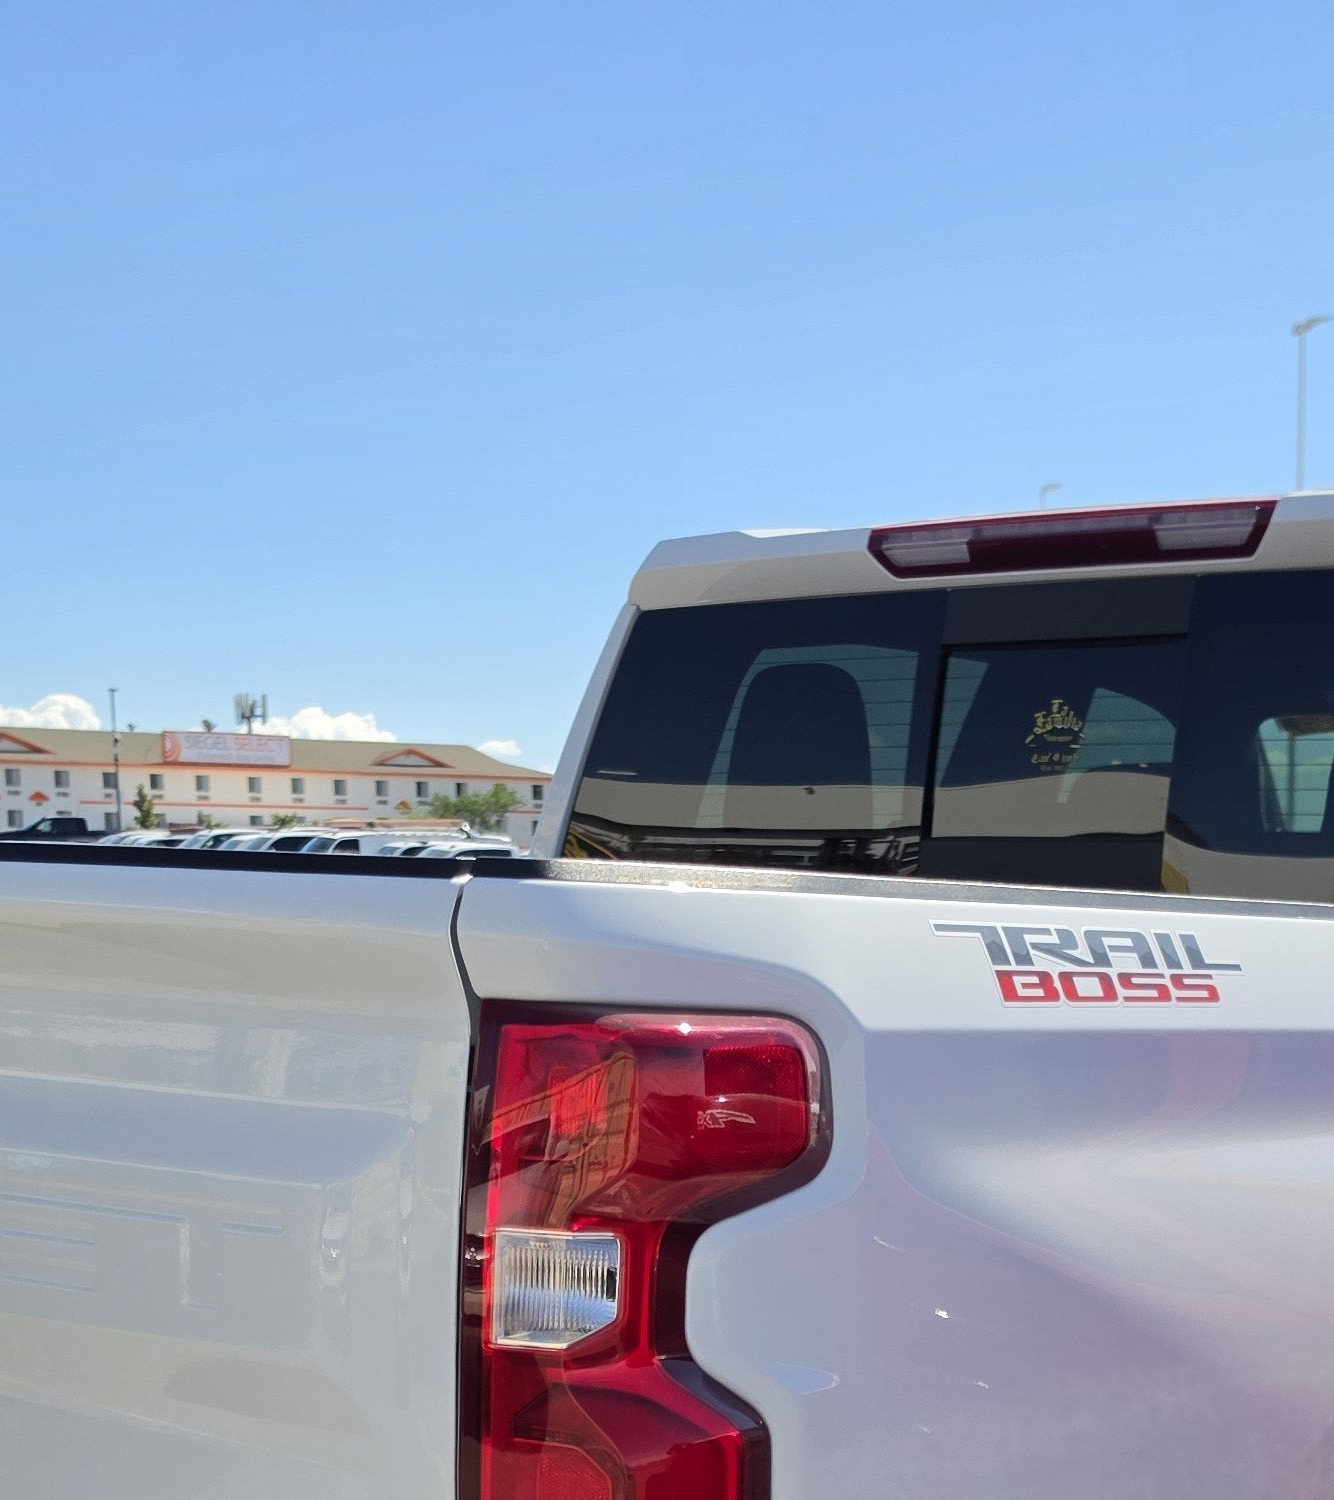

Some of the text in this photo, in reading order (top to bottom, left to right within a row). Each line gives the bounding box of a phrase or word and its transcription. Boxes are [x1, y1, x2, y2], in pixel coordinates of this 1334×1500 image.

[233, 737, 285, 753] SELECT
[931, 921, 1243, 972] TRAIL
[994, 968, 1221, 1004] BOSS
